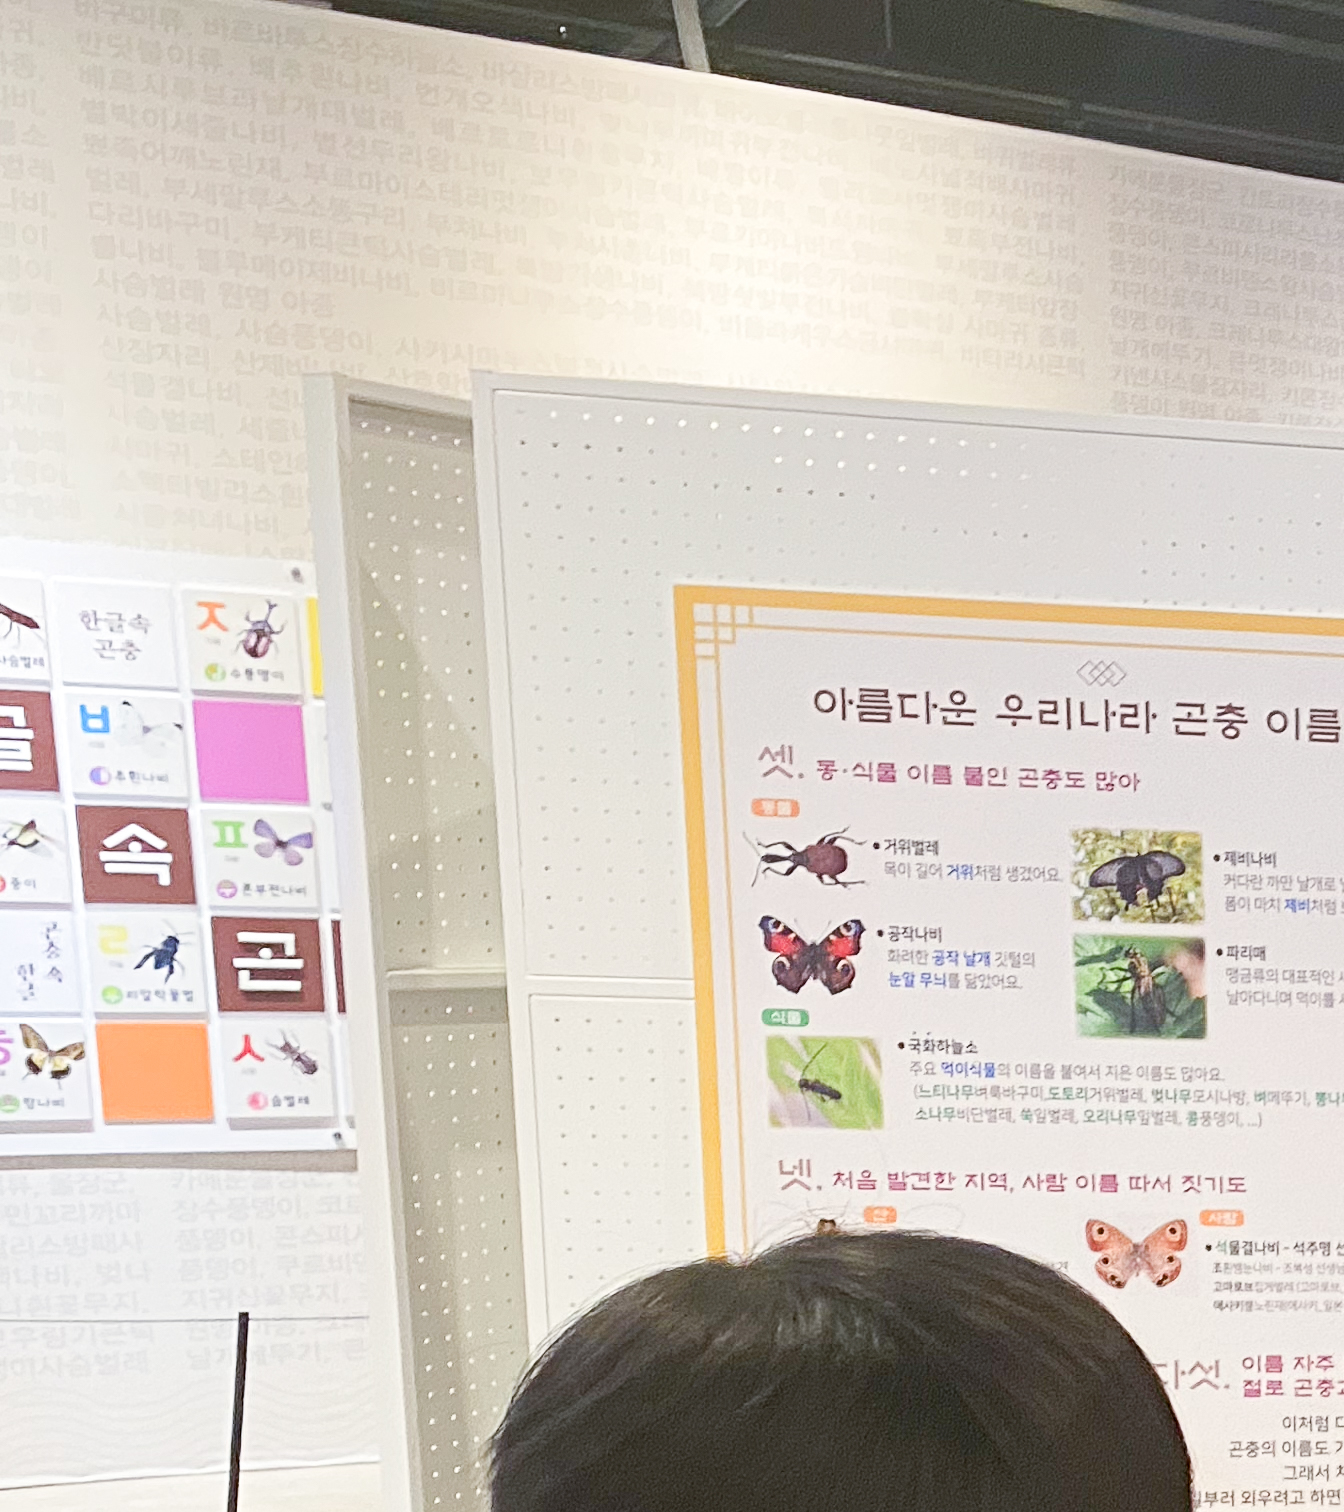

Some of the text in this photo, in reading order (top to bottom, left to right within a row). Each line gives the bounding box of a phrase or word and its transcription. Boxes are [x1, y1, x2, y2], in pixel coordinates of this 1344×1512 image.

[814, 686, 977, 726] 아름다운
[995, 694, 1158, 734] 우리나라
[1172, 702, 1249, 740] 곤충
[1266, 708, 1342, 743] 이름
[758, 744, 805, 779] 셋.
[907, 763, 953, 786] 이름
[1018, 768, 1086, 790] 곤충도
[1095, 771, 1142, 792] 많아
[99, 823, 173, 887] 속
[883, 839, 940, 858] 거위벌레
[1223, 851, 1278, 868] 제비나비
[947, 864, 1001, 882] 거위처럼
[1284, 898, 1337, 916] 제비처럼
[888, 926, 943, 944] 공작나비
[233, 931, 304, 992] 곤
[932, 950, 960, 966] 공작
[963, 951, 991, 967] 날개
[1226, 945, 1267, 962] 파리매
[908, 1038, 978, 1055] 국화하늘소
[909, 1061, 936, 1077] 주요
[1015, 1063, 1055, 1080] 이름을
[1136, 1065, 1177, 1082] 이름도
[778, 1158, 1248, 1194] 넷. 처음 발견한 지역, 사람 이름 따서 짓기도
[1242, 1354, 1284, 1373] 이름
[1293, 1354, 1336, 1373] 자주
[1242, 1377, 1285, 1397] 절로
[1281, 1414, 1330, 1433] 이처럼
[1228, 1439, 1276, 1458] 곤충의
[1281, 1438, 1330, 1457] 이름도
[1283, 1464, 1330, 1482] 그래서
[1241, 1489, 1306, 1508] 외우려고
[1310, 1488, 1342, 1507] 하면
